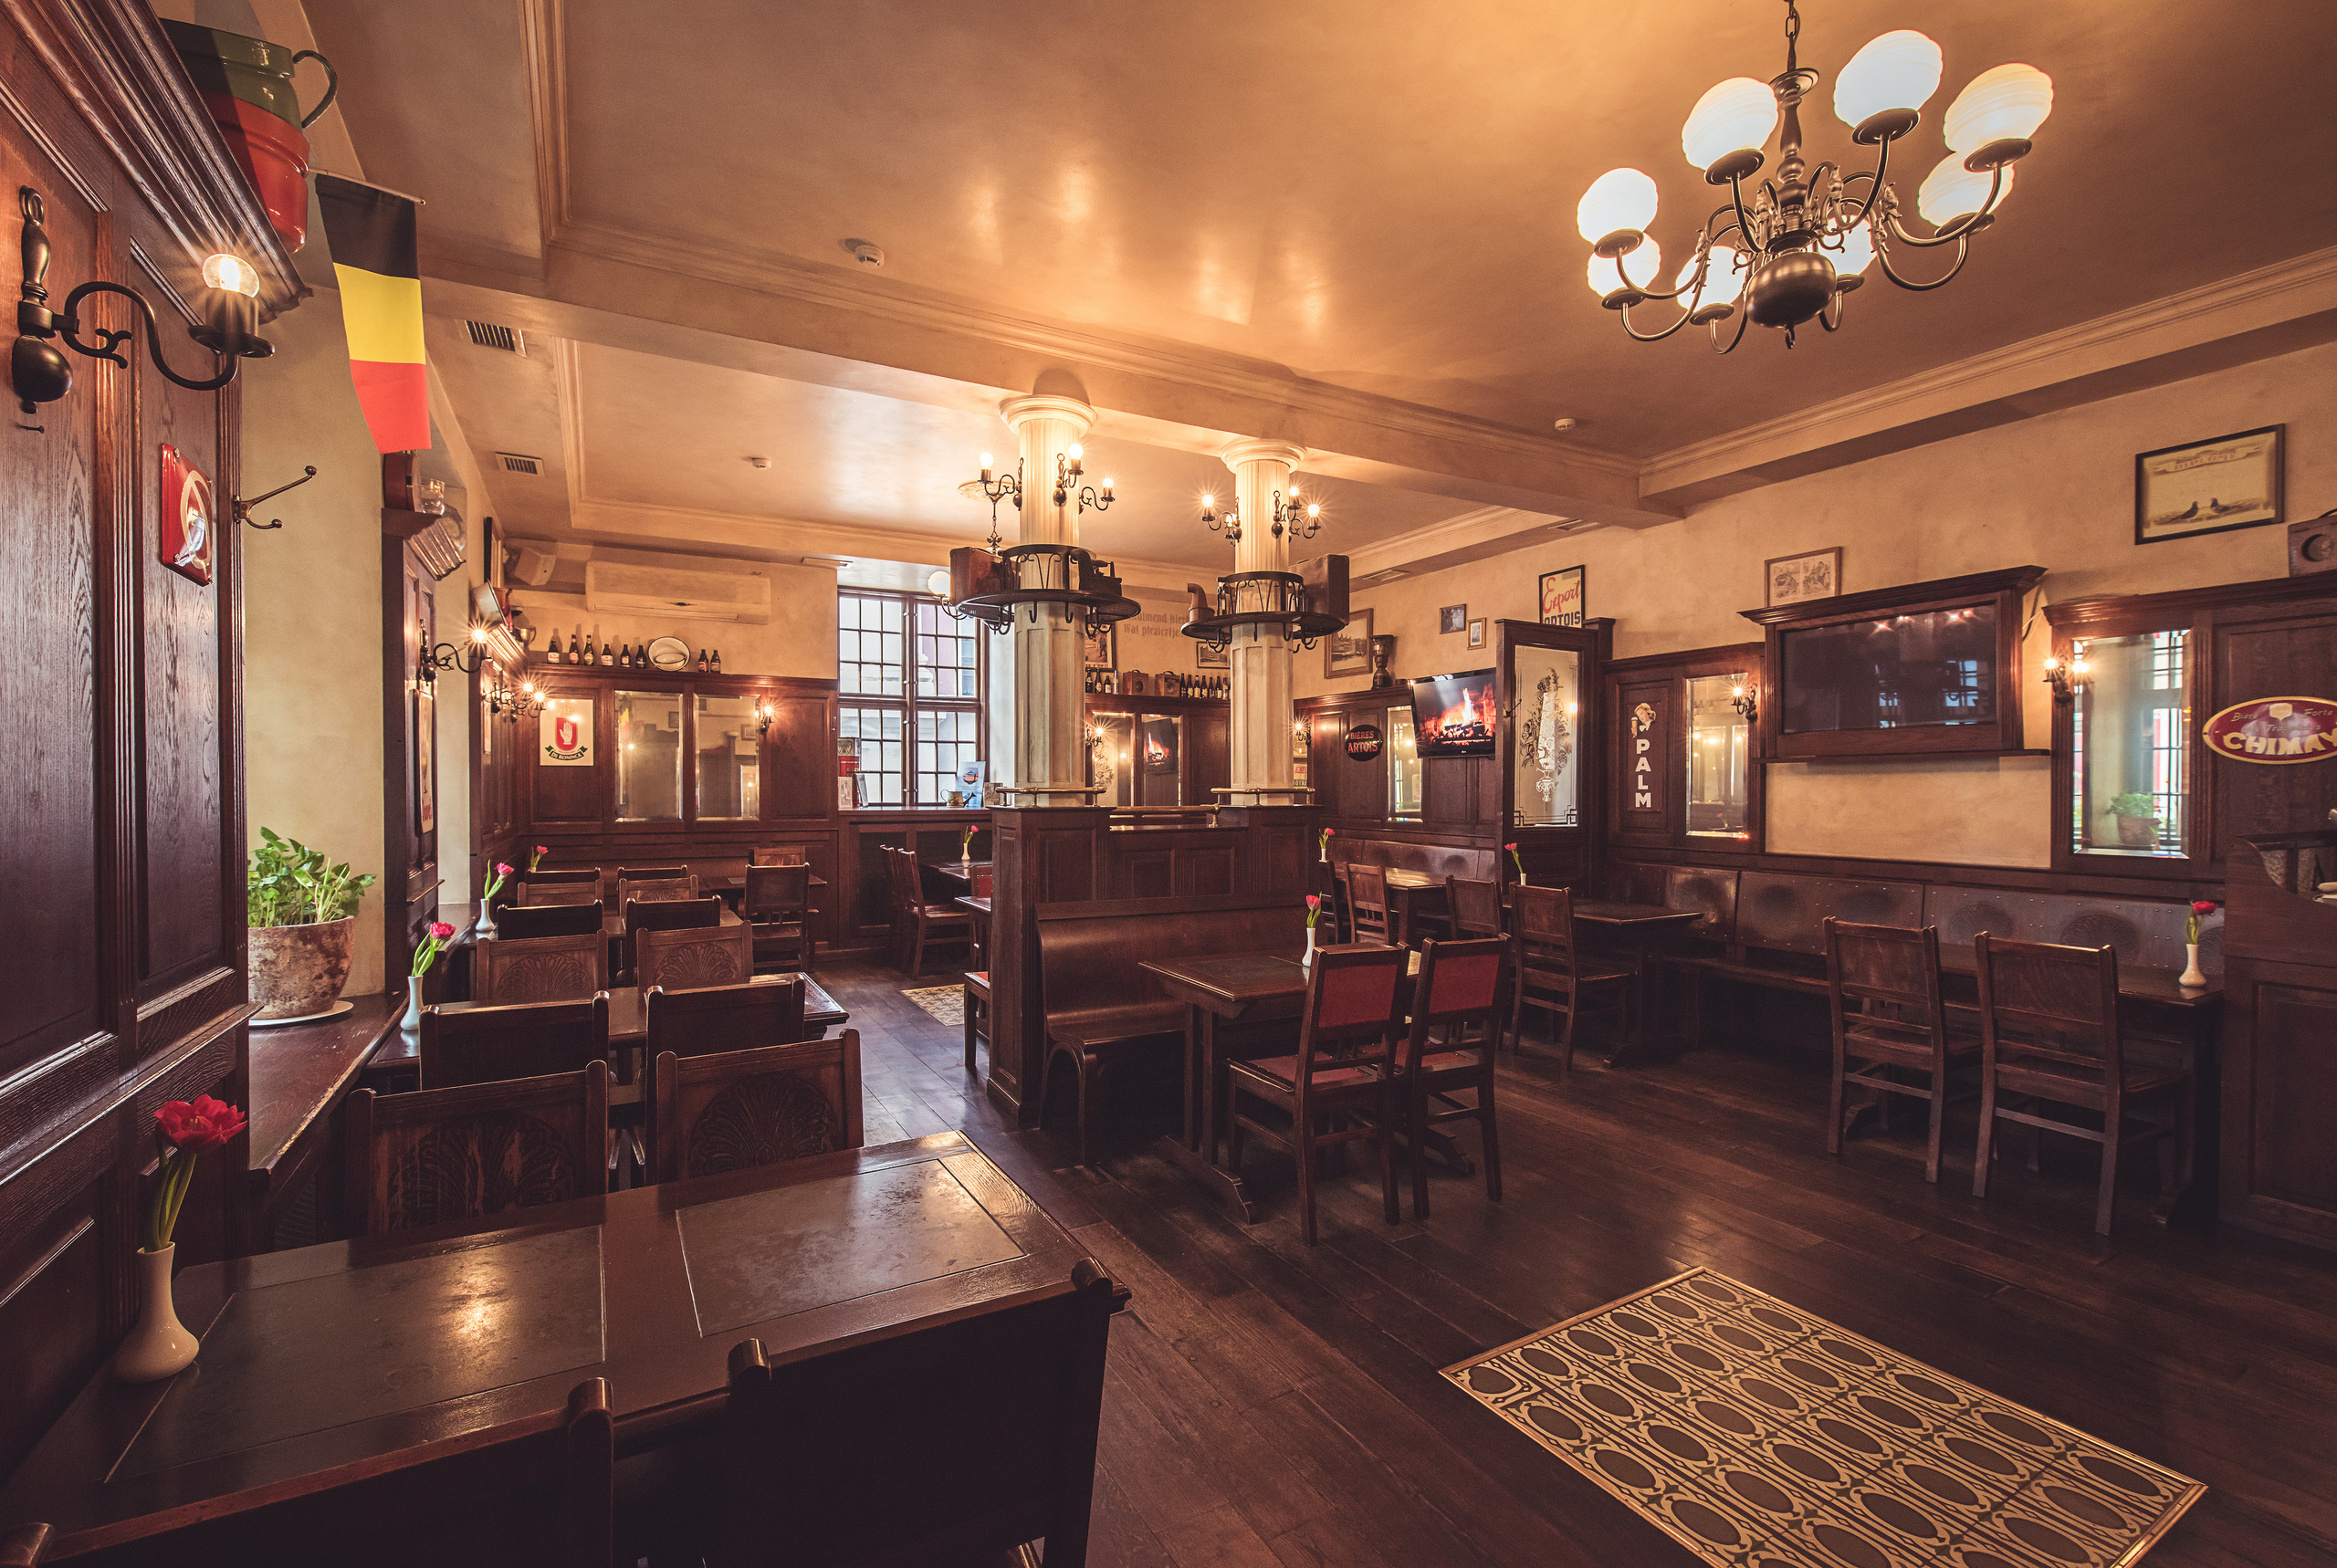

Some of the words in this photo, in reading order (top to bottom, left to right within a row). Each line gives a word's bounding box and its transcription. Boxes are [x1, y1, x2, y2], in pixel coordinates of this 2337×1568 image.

[1543, 577, 1581, 613] Export
[1124, 624, 1139, 634] Wat
[2303, 708, 2333, 718] Forte
[1347, 740, 1378, 753] ARTOIS
[1635, 738, 1651, 808] PALM
